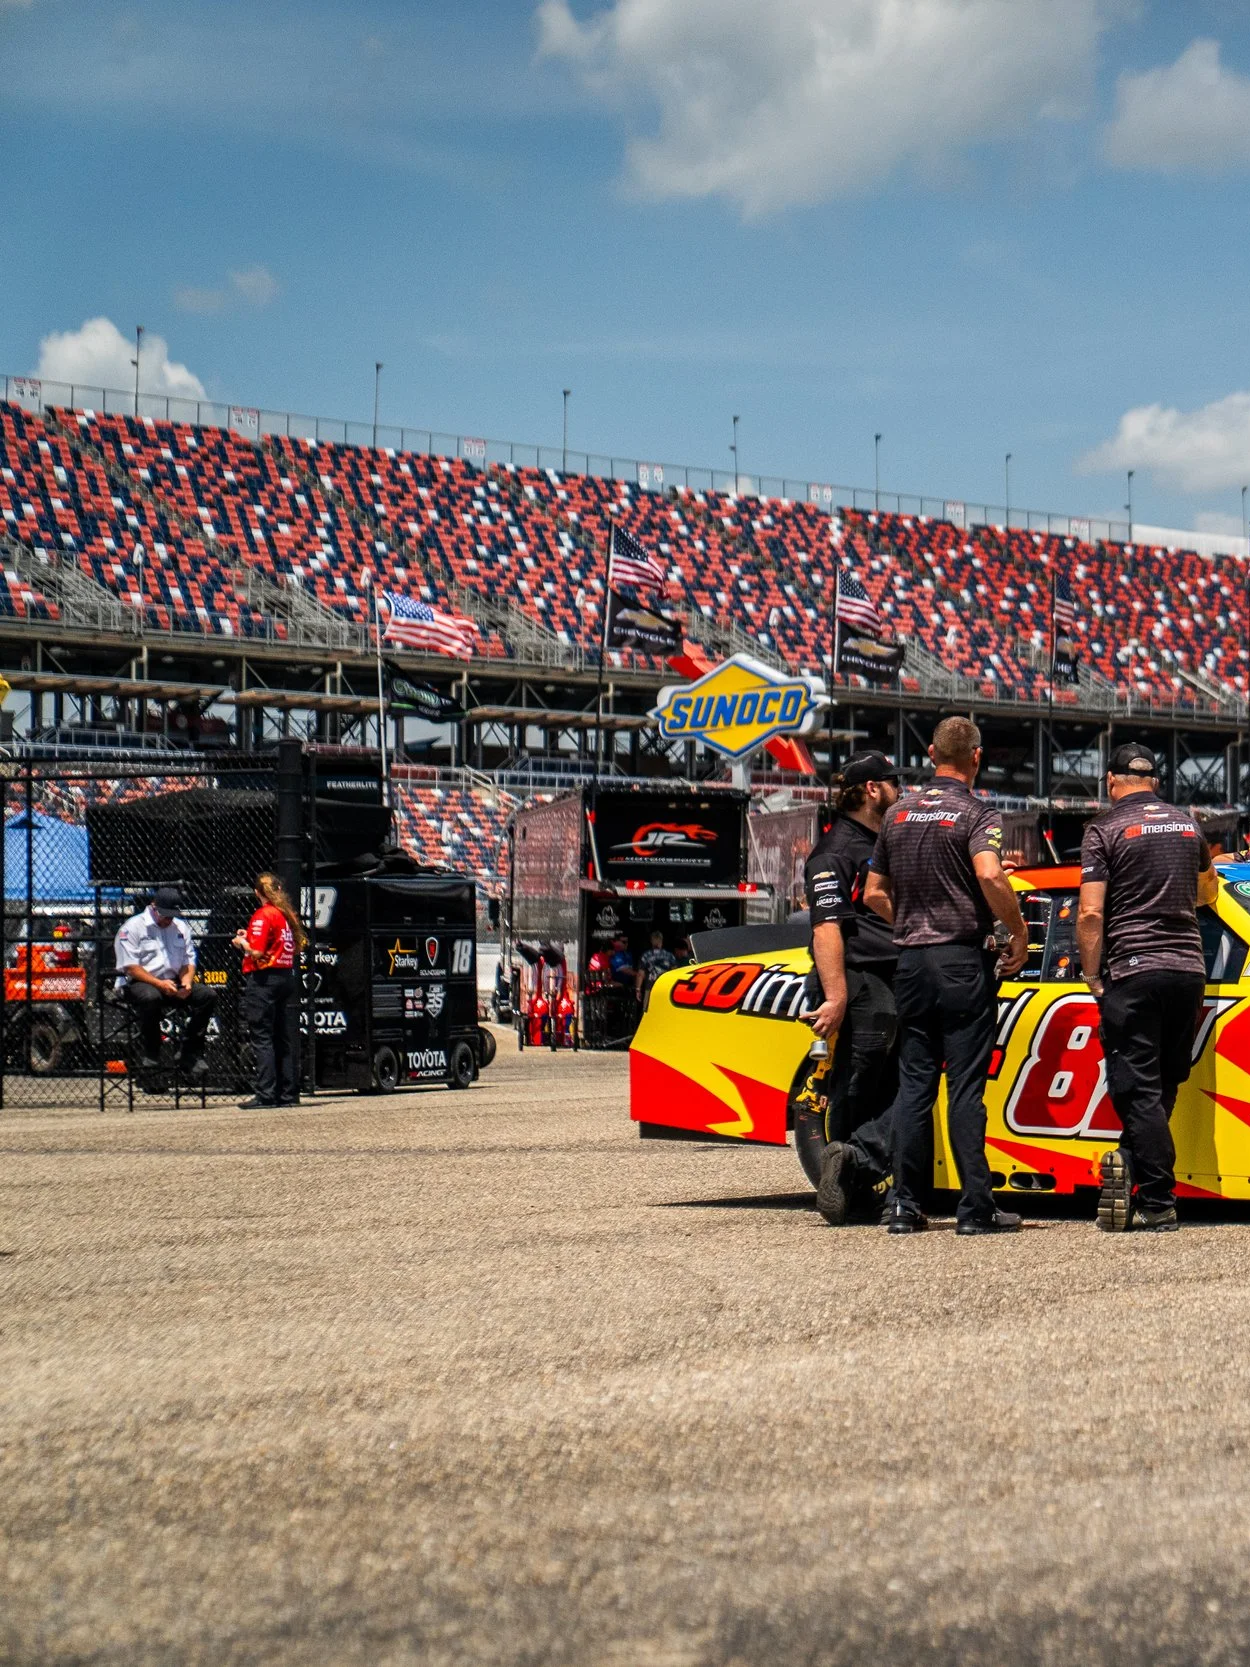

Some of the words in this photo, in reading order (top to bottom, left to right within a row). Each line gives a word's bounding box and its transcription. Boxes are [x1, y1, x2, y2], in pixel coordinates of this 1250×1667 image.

[668, 690, 804, 729] SUNOCO
[326, 781, 378, 789] FEATHERLITE
[300, 950, 338, 966] Srkey
[394, 954, 418, 971] Starkey
[452, 938, 473, 975] 18
[204, 971, 228, 984] 300
[407, 1051, 447, 1069] TOYOTA
[408, 1069, 447, 1079] RACING
